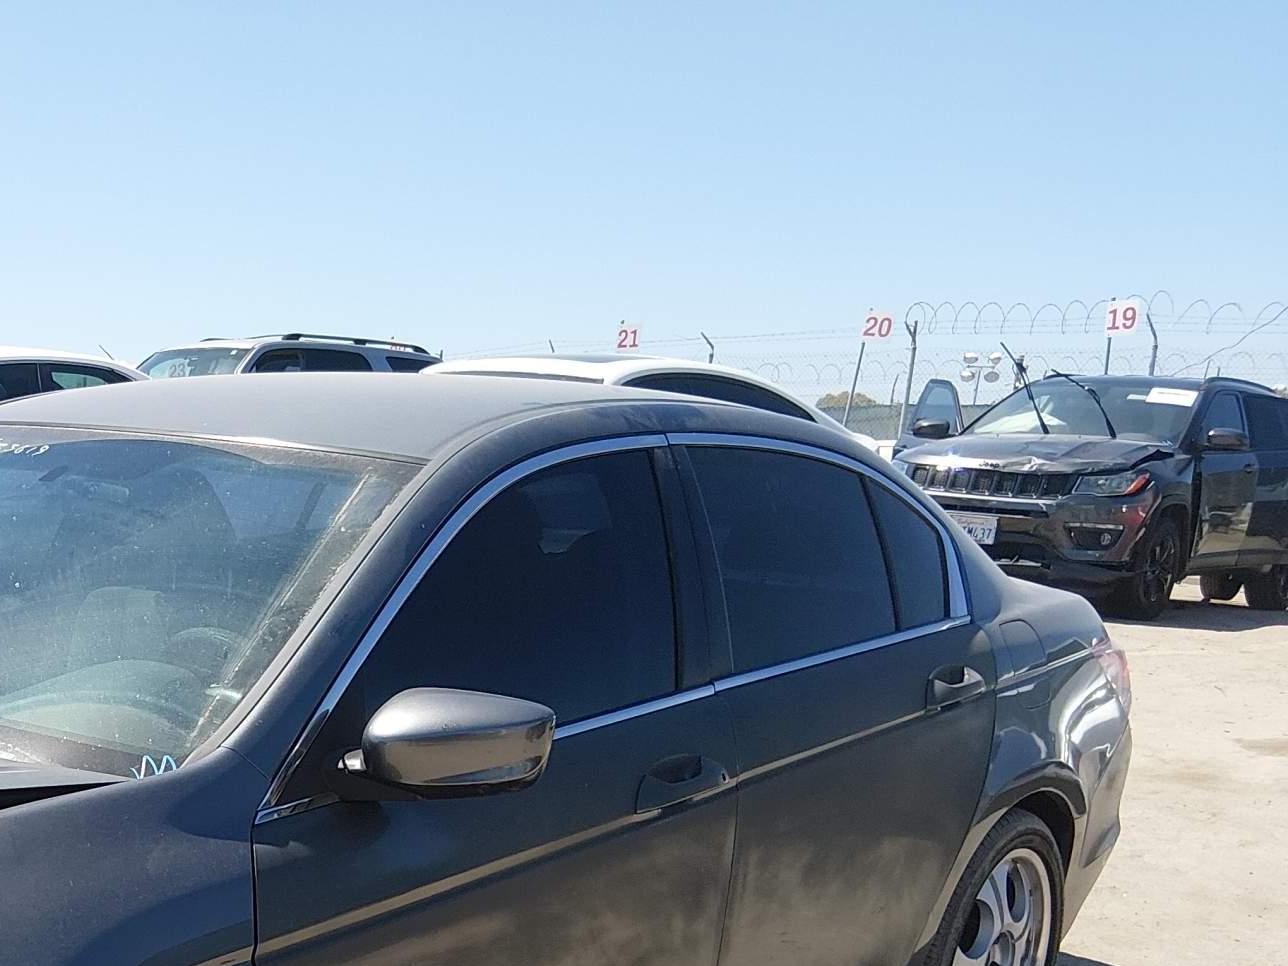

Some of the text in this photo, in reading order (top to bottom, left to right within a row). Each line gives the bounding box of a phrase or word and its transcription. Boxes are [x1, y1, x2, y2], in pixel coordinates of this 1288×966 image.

[863, 316, 892, 337] 20
[1107, 307, 1136, 330] 19
[617, 329, 639, 348] 21
